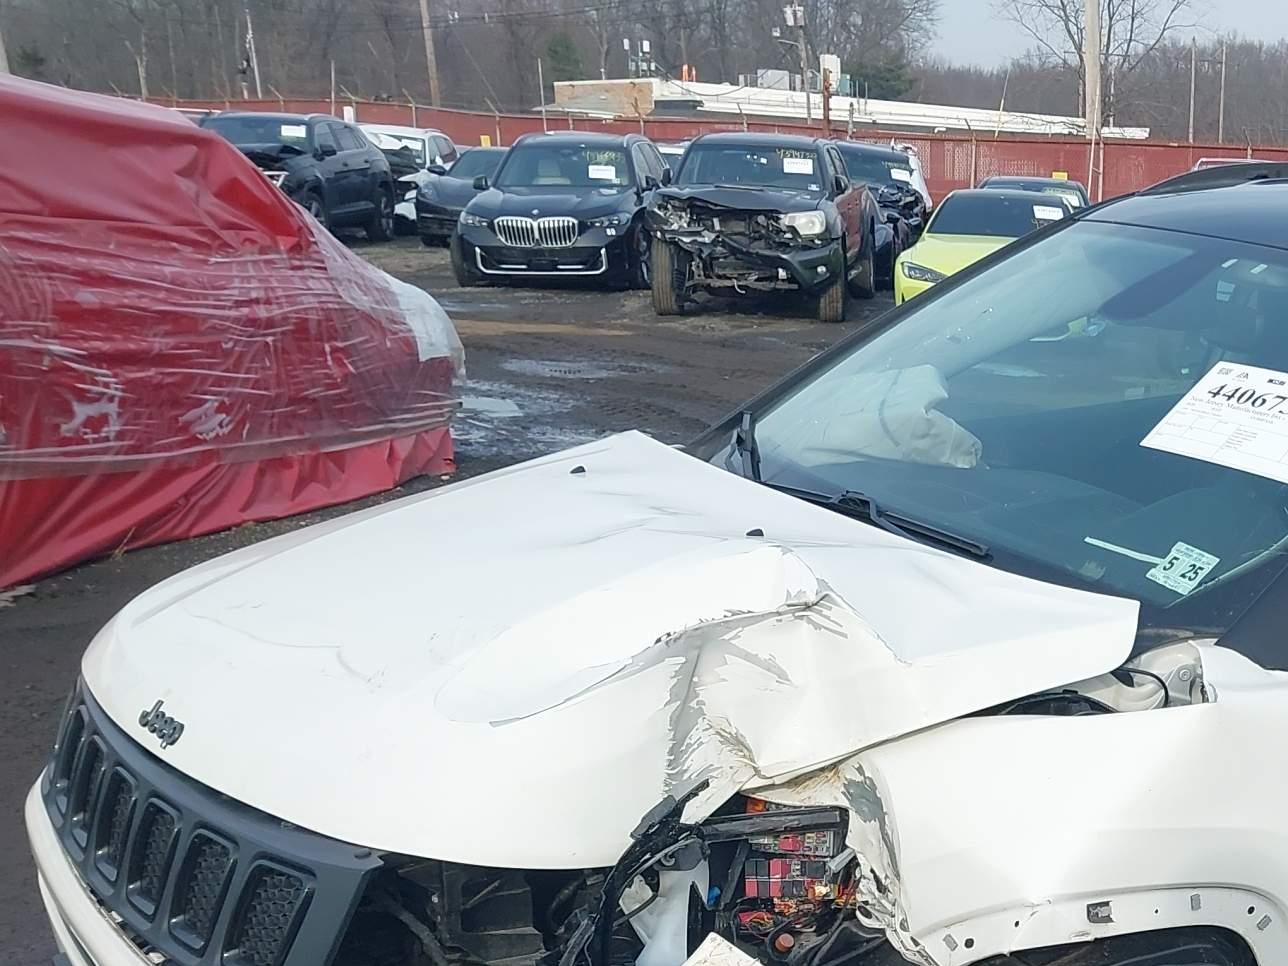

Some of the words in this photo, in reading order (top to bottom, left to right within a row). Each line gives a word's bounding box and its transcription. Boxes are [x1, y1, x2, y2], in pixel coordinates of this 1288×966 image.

[1162, 556, 1180, 571] 5
[1179, 563, 1205, 582] 25
[138, 699, 185, 750] Jeep
